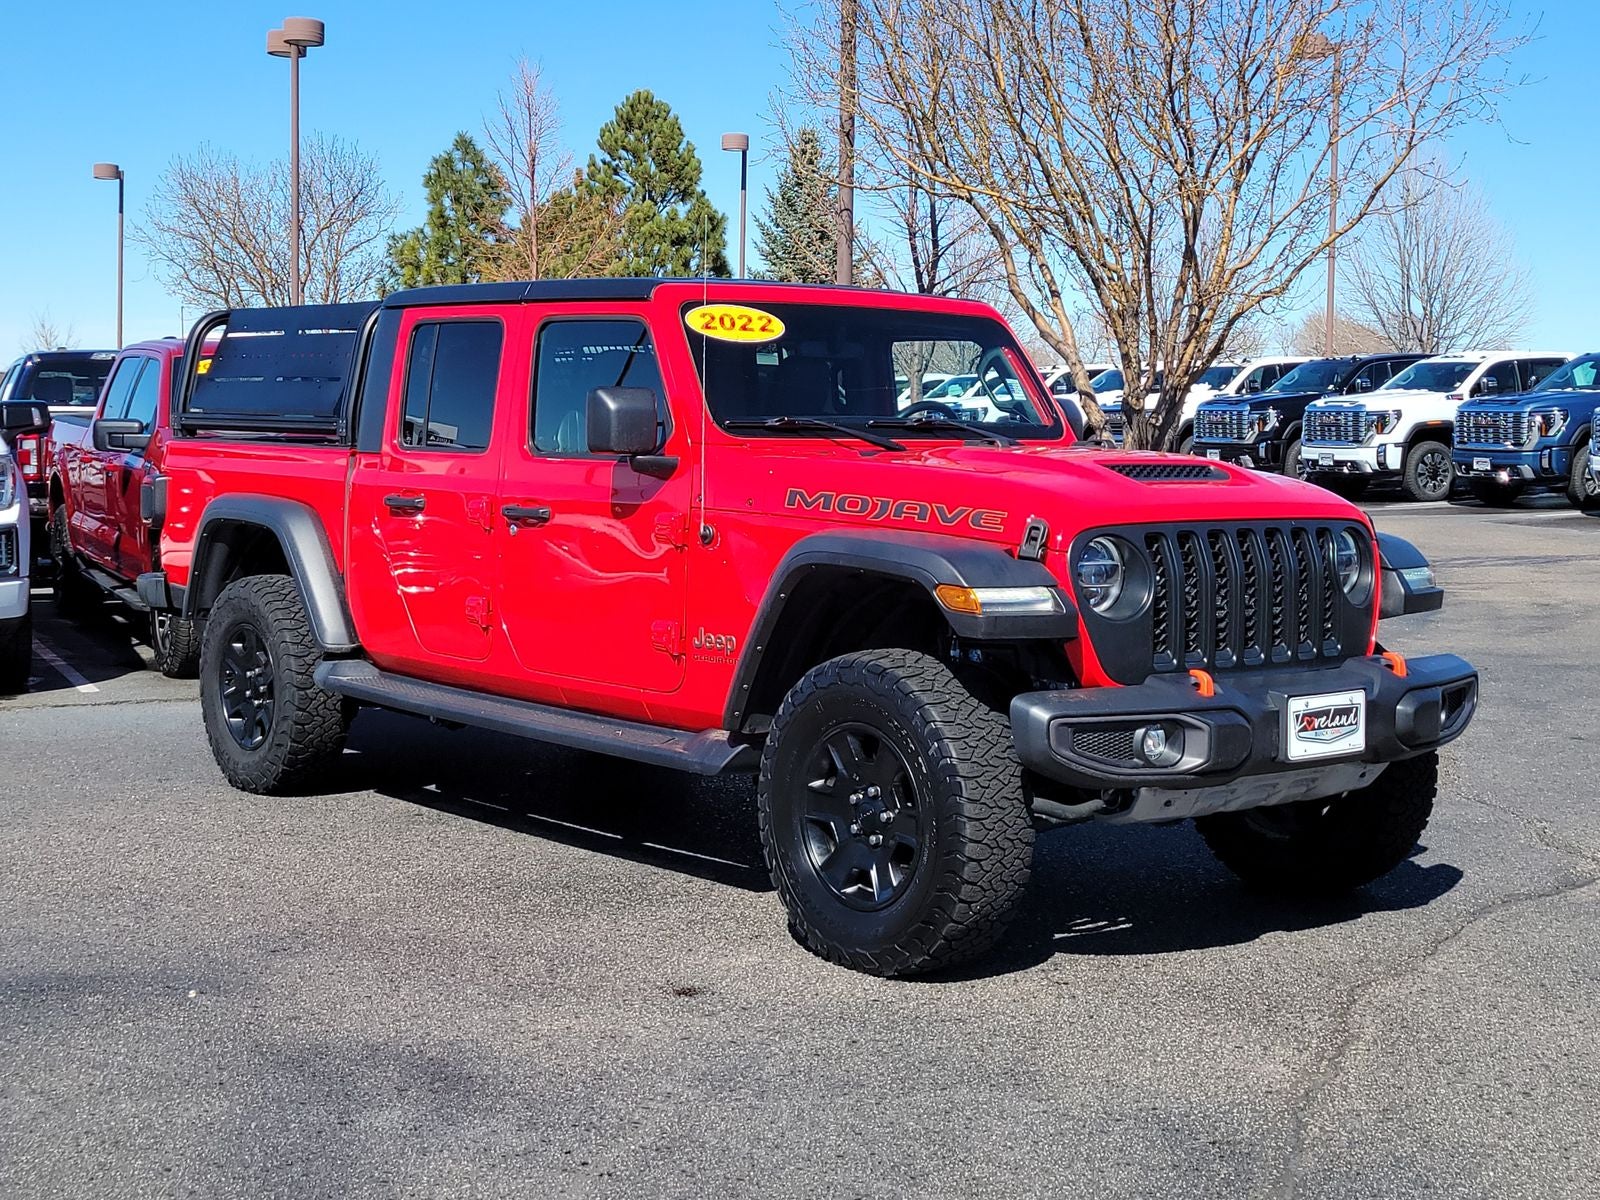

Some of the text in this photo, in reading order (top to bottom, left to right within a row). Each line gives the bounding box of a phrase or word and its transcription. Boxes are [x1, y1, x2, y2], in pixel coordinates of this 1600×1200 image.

[700, 312, 775, 333] 2022
[785, 488, 1008, 532] MOJAVE
[693, 626, 736, 656] Jeep
[1296, 707, 1358, 733] Loveland
